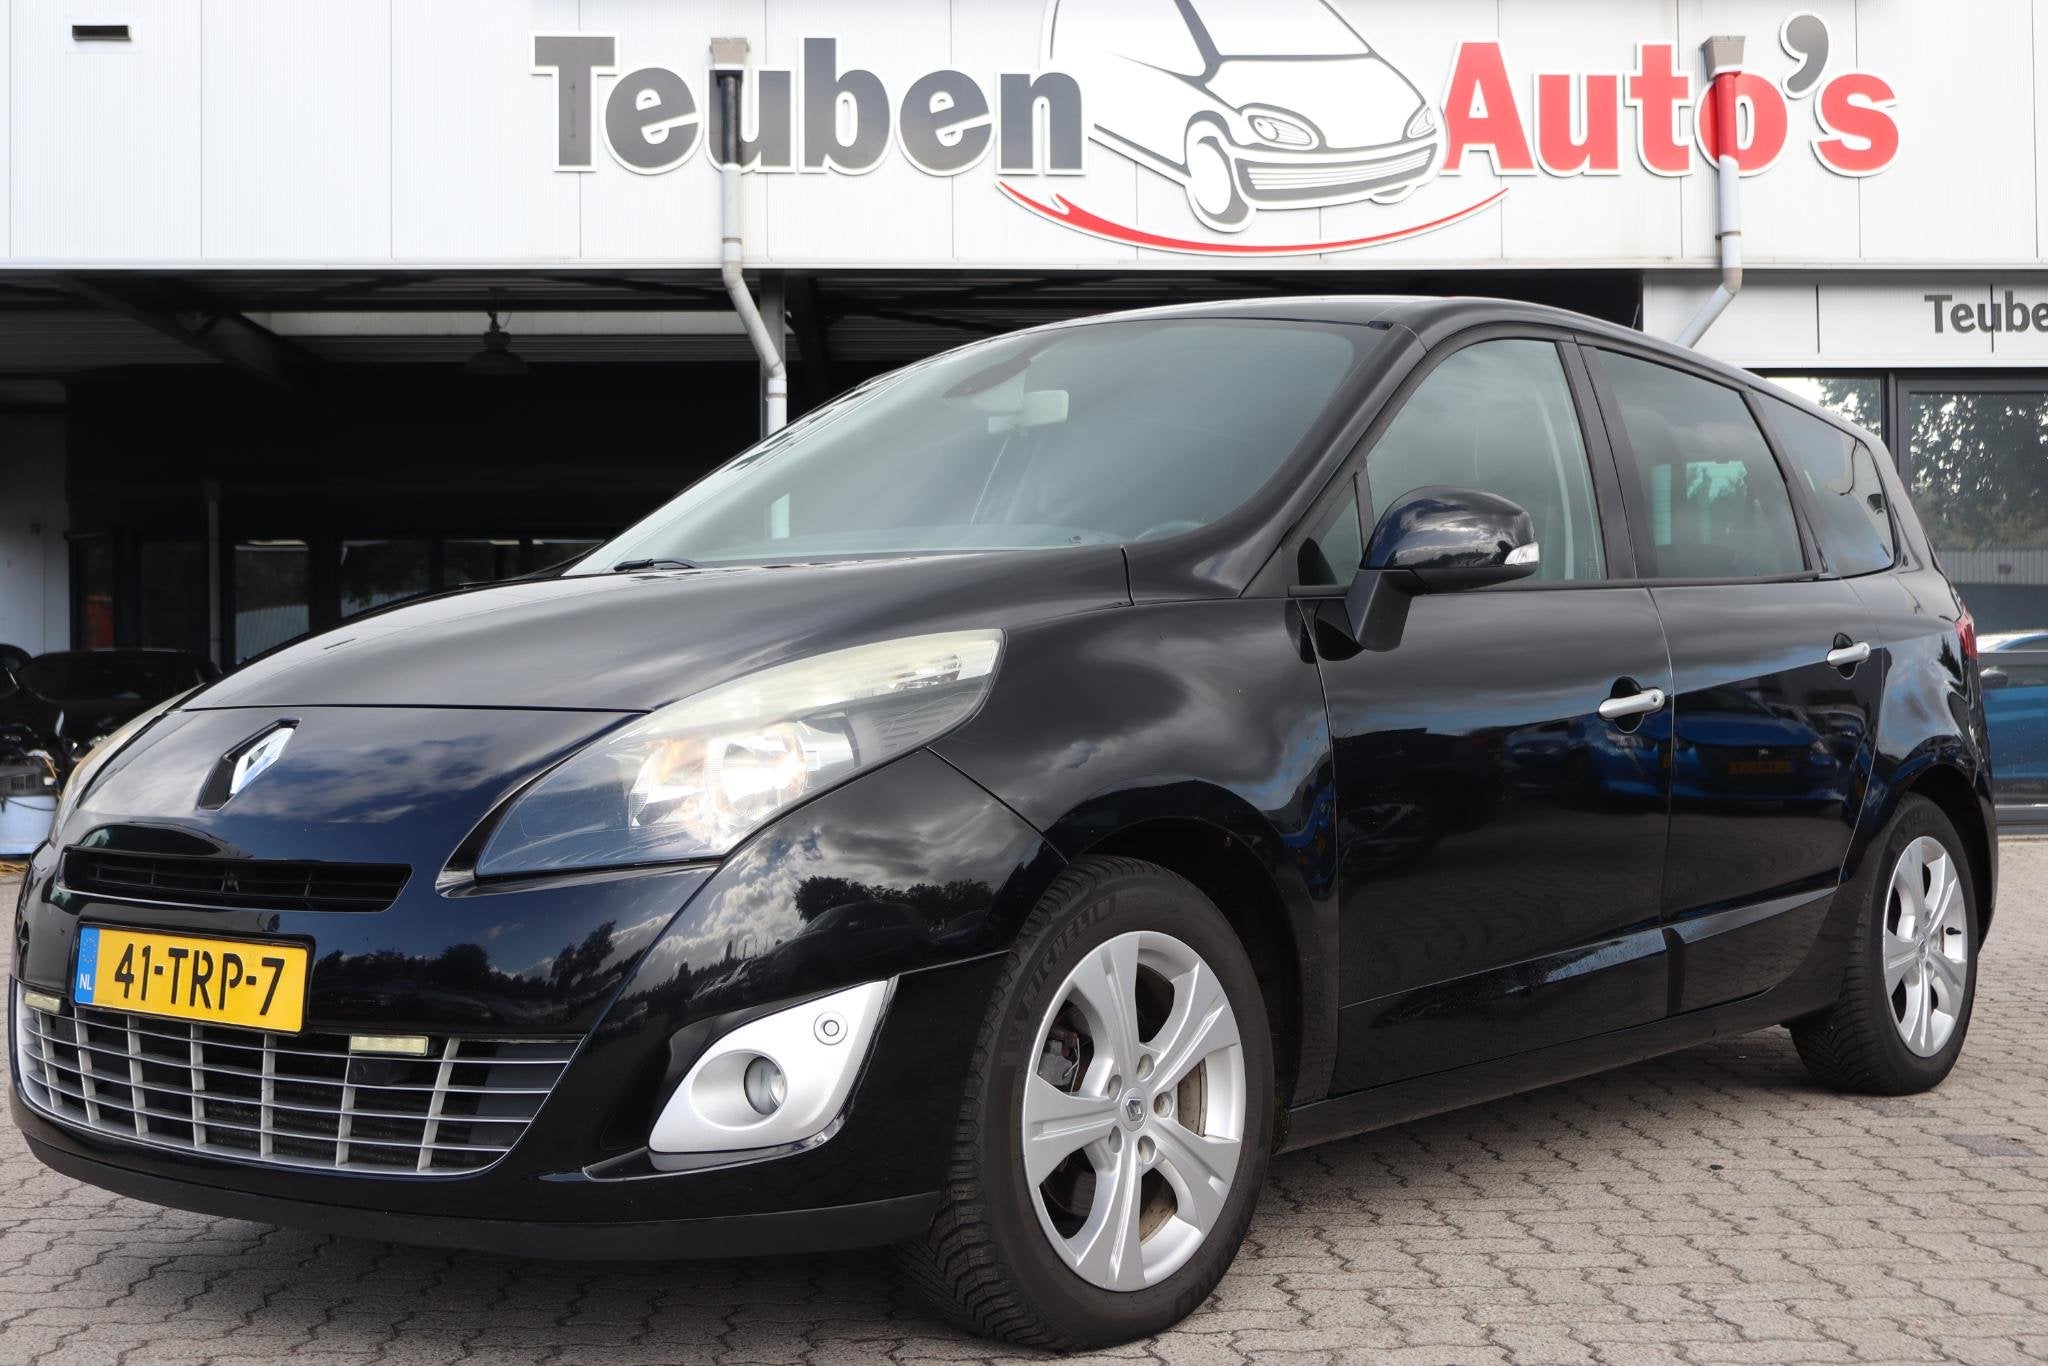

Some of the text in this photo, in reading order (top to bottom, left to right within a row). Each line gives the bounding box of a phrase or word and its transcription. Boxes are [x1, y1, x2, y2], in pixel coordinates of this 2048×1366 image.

[533, 13, 1899, 173] Teuben Auto's
[1924, 290, 2048, 334] Teube
[79, 943, 286, 1016] NL 41-TRP-7
[1022, 894, 1116, 1009] MICHELIN
